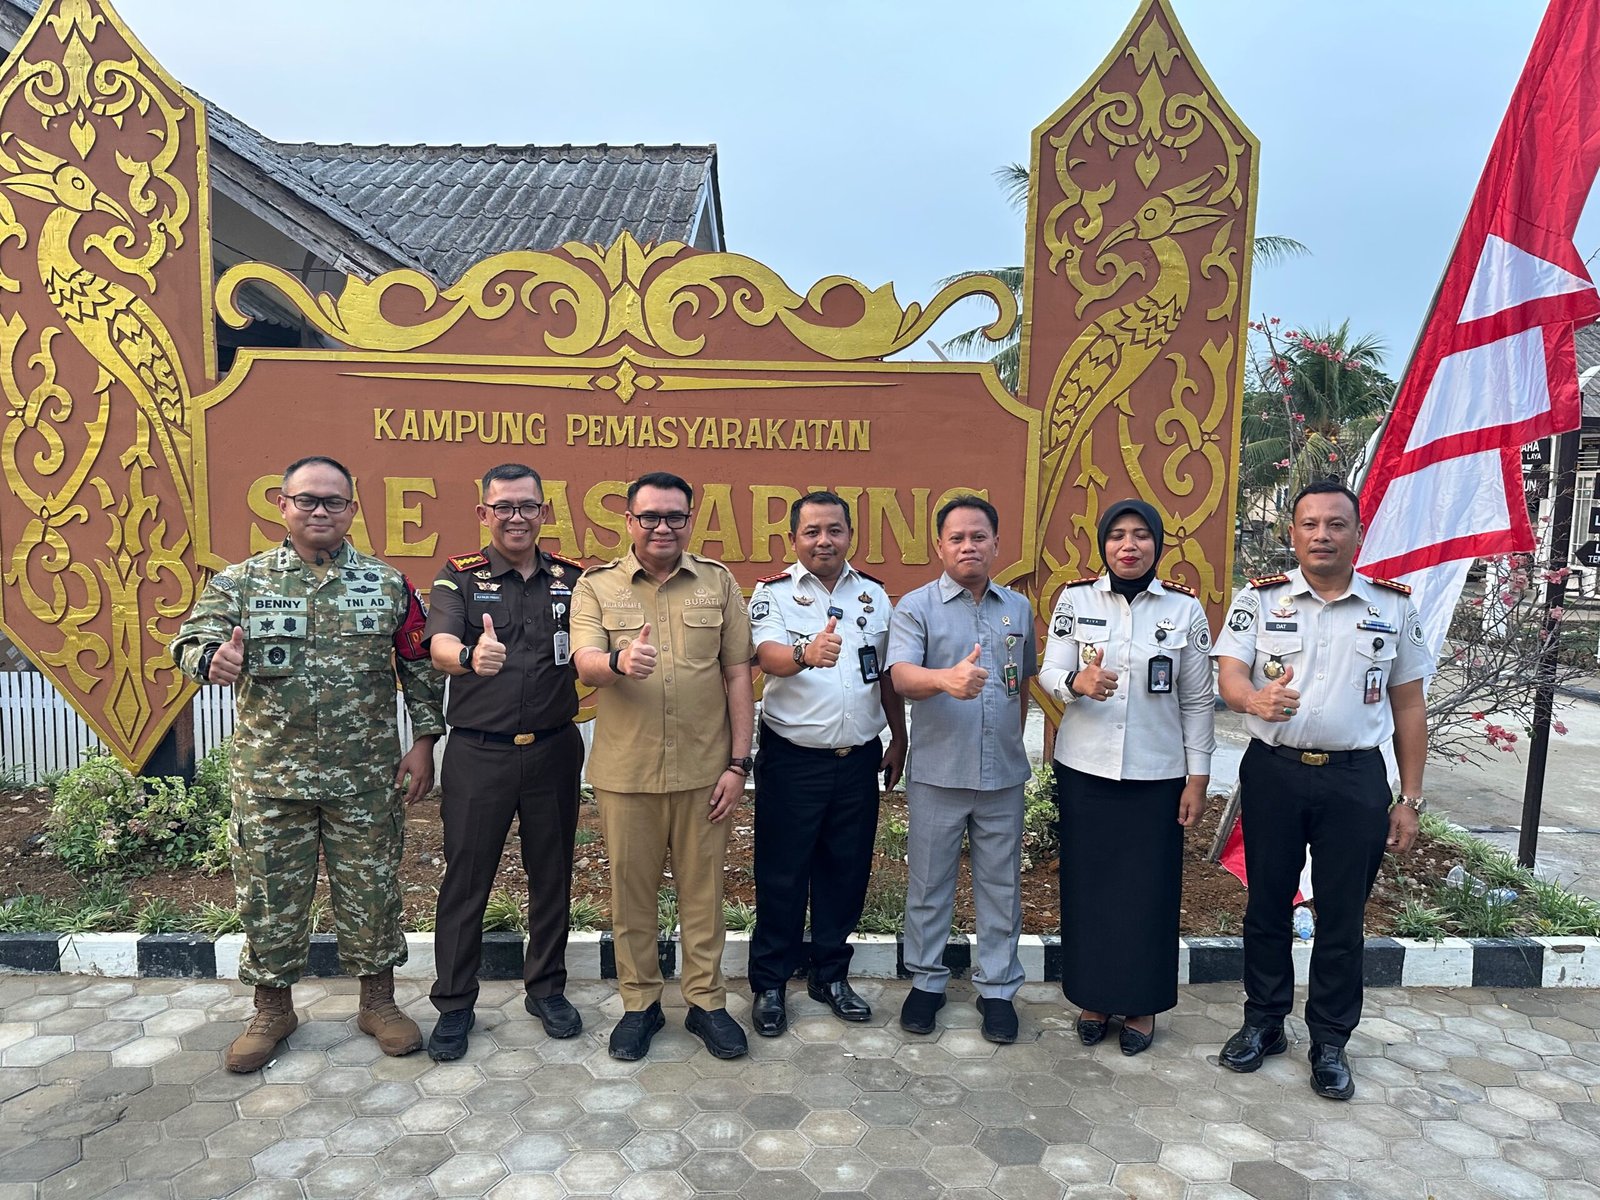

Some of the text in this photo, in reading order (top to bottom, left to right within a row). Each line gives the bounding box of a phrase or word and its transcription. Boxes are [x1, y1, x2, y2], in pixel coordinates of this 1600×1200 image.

[373, 408, 871, 451] KAMPUNG PEMASYARAKATAN
[255, 600, 301, 609] BENNY
[345, 598, 385, 608] TNI AD
[684, 598, 719, 606] BUPATI
